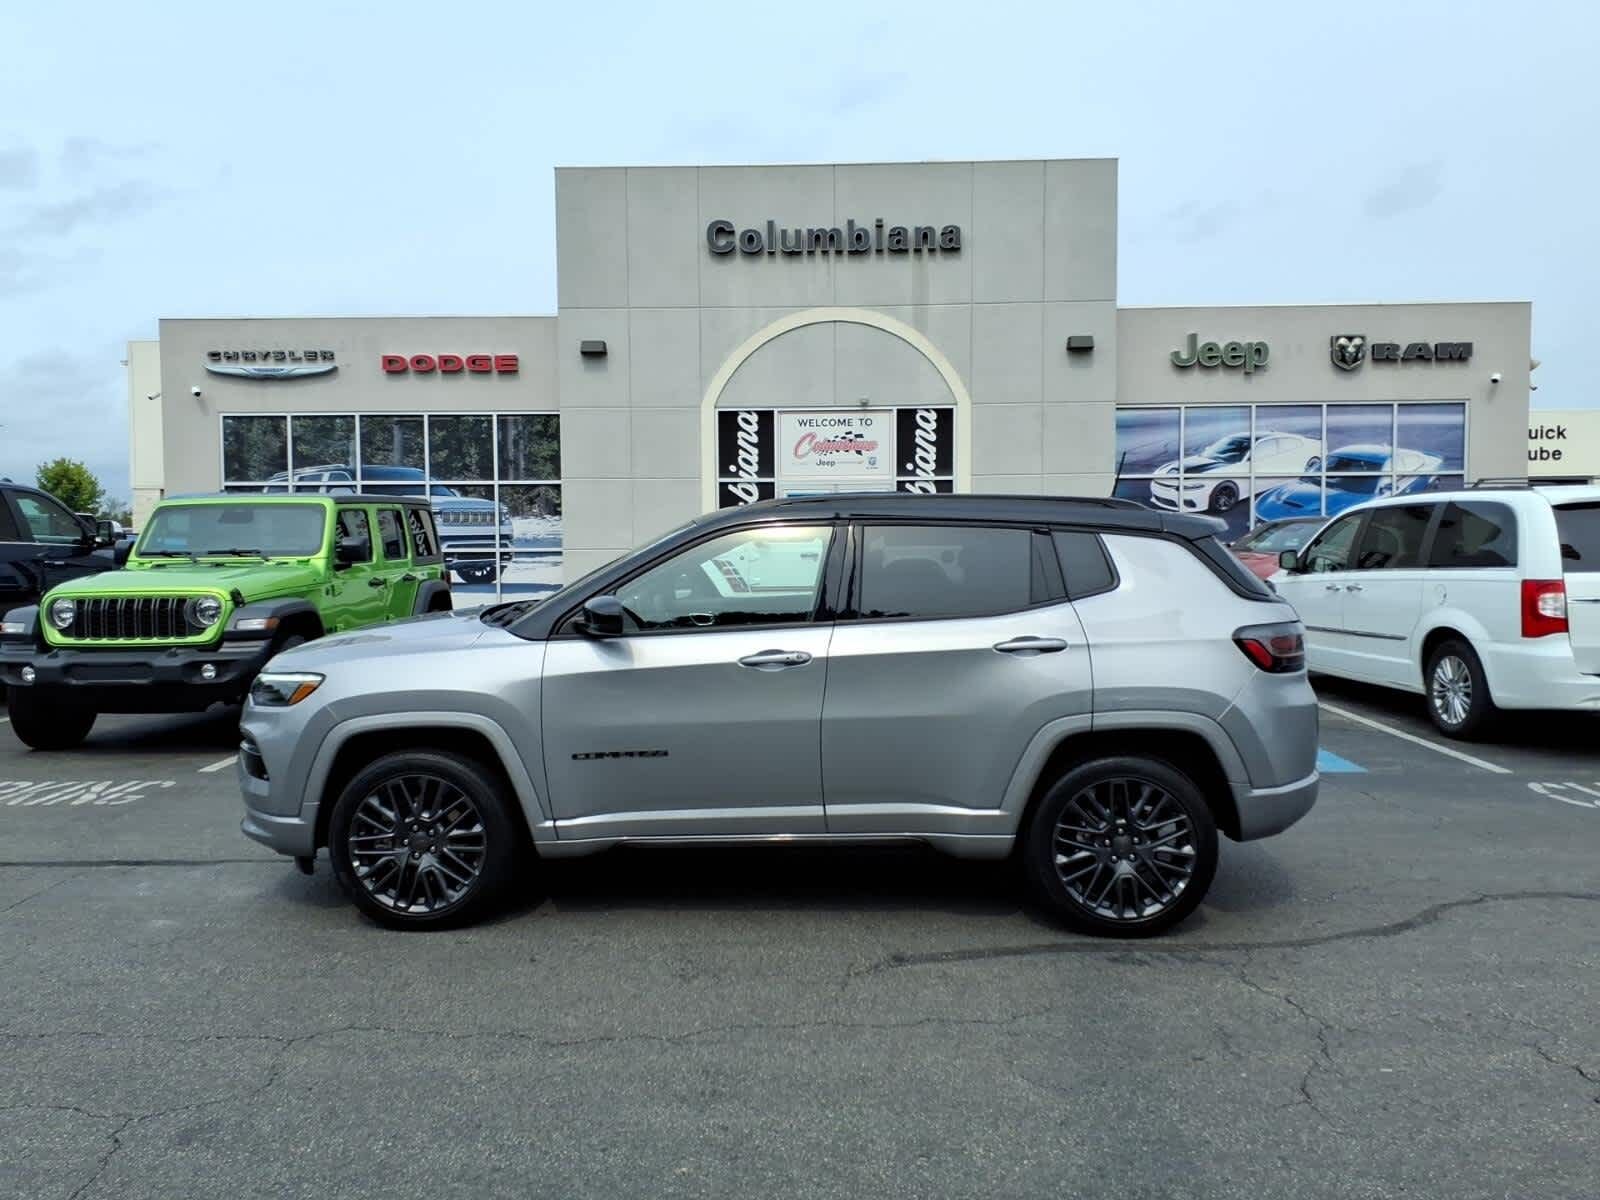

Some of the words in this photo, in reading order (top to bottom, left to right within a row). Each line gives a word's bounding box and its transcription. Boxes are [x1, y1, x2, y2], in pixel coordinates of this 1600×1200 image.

[706, 219, 962, 254] Columbiana
[207, 350, 336, 362] CHRYSLER
[1170, 332, 1270, 374] Jeep
[1371, 341, 1473, 361] RAM
[381, 354, 520, 374] DODGE
[797, 418, 854, 428] WELCOME
[858, 418, 874, 427] TO
[1528, 424, 1568, 440] uick
[727, 410, 759, 505] biana
[904, 408, 938, 495] biana
[1528, 446, 1563, 461] ube
[815, 459, 836, 468] Jeep
